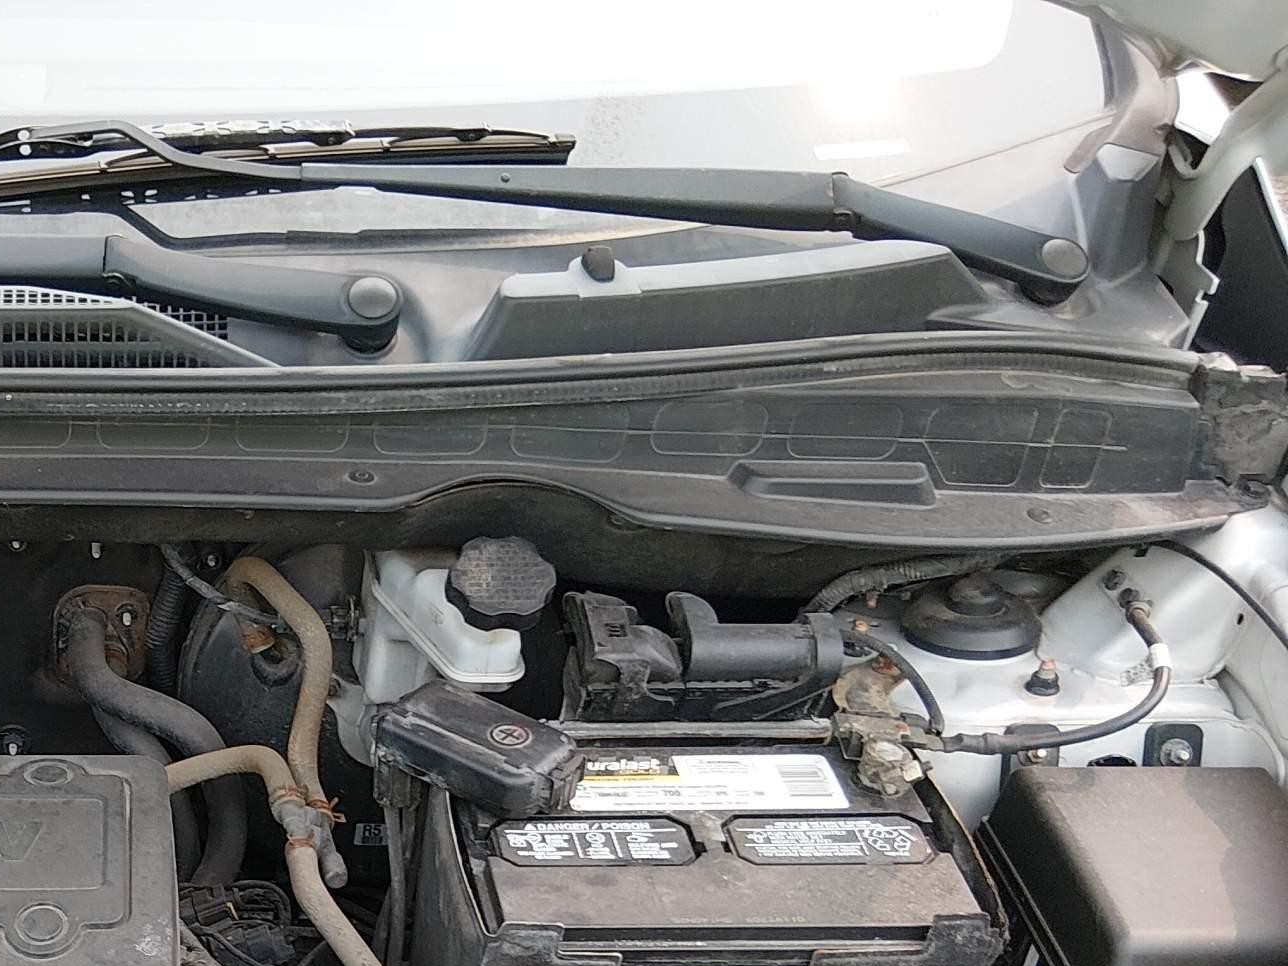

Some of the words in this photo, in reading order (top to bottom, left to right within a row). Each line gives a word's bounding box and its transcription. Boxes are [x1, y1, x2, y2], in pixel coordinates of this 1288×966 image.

[587, 758, 661, 771] uralast
[537, 823, 589, 831] DANGER
[601, 822, 650, 830] POISON
